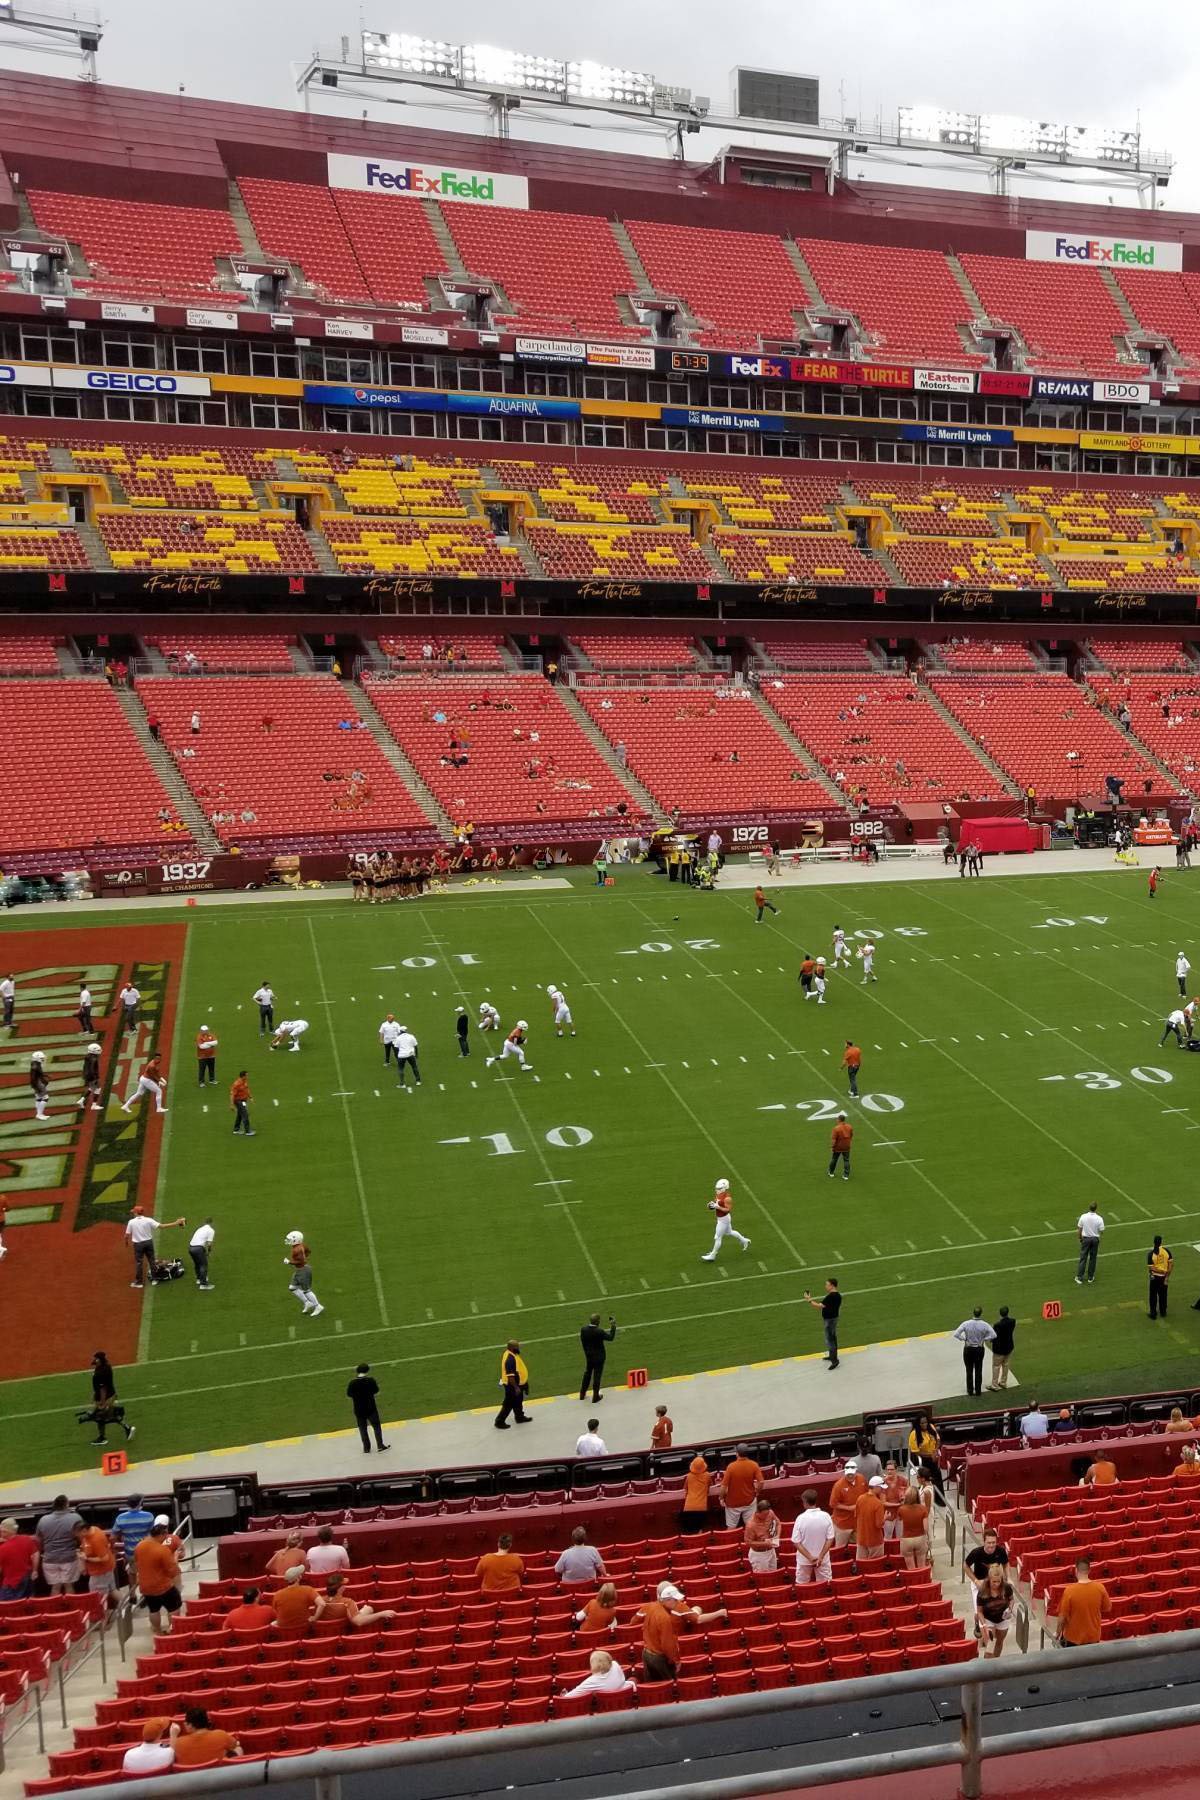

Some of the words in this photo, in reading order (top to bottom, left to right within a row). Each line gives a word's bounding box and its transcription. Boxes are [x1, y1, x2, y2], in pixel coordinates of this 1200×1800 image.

[366, 163, 493, 200] FedExField
[1056, 237, 1155, 265] FedExField
[327, 328, 353, 336] HARVEY
[519, 339, 573, 353] Carpetland
[621, 355, 651, 363] LEARN
[731, 357, 782, 377] FedEx
[796, 362, 909, 384] #FEARTHETURTLE
[87, 372, 177, 393] GEICO
[1038, 381, 1090, 397] RE/MAX
[370, 393, 401, 404] pepsi
[1108, 384, 1139, 398] BDO
[489, 399, 540, 415] AQUAFINA
[701, 413, 731, 426] Merrill
[732, 415, 760, 428] Lynch
[938, 429, 966, 441] Merrill
[967, 431, 991, 442] Lynch
[1093, 438, 1128, 447] MARYLAND
[1143, 441, 1171, 449] LOTTERY
[732, 826, 769, 842] 1972
[850, 820, 884, 836] 1982
[162, 861, 210, 882] 1937
[1073, 1066, 1174, 1090] 30
[795, 1093, 905, 1121] 20
[481, 1125, 594, 1156] 10
[1046, 1302, 1060, 1318] 20
[628, 1370, 646, 1387] 10
[108, 1454, 122, 1473] G
